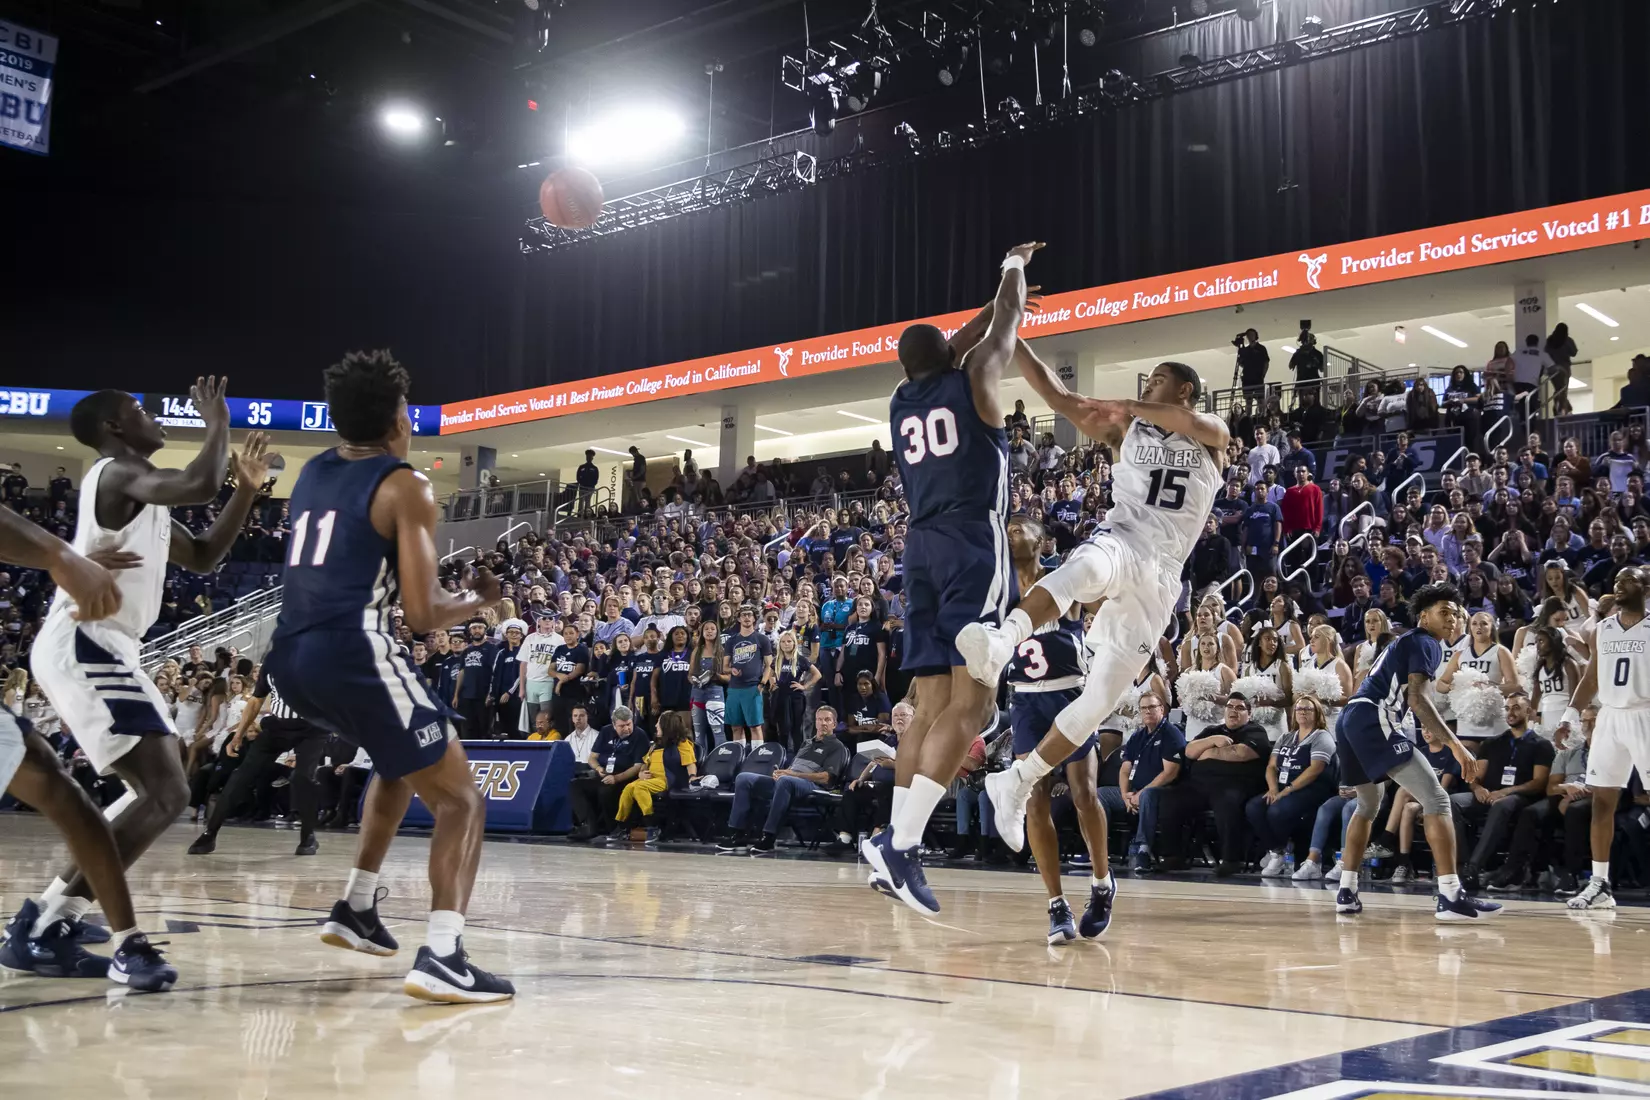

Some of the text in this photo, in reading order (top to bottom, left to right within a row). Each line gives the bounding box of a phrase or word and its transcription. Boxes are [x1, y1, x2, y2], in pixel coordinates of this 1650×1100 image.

[0, 51, 33, 70] 2019
[1341, 248, 1414, 275] Provider
[1419, 235, 1466, 261] Food
[1471, 226, 1538, 253] Service
[1541, 212, 1600, 240] Voted
[1605, 208, 1632, 231] #1
[1021, 269, 1279, 329] Private College Food in California!
[801, 346, 849, 366] Provider
[851, 337, 882, 357] Food
[161, 397, 201, 417] 14:4
[440, 359, 762, 427] Provider Food Service Voted #1 Best Private College Food in California!
[247, 402, 273, 425] 35
[412, 421, 420, 432] 4
[414, 408, 421, 419] 2
[900, 407, 959, 465] 30
[1134, 445, 1202, 468] LANCERS
[1145, 468, 1190, 510] 15
[289, 510, 337, 567] 11
[1018, 638, 1049, 679] 3
[1602, 641, 1646, 655] LANCERS
[672, 663, 690, 672] CBU
[1614, 657, 1630, 687] 0
[467, 760, 530, 800] ERS
